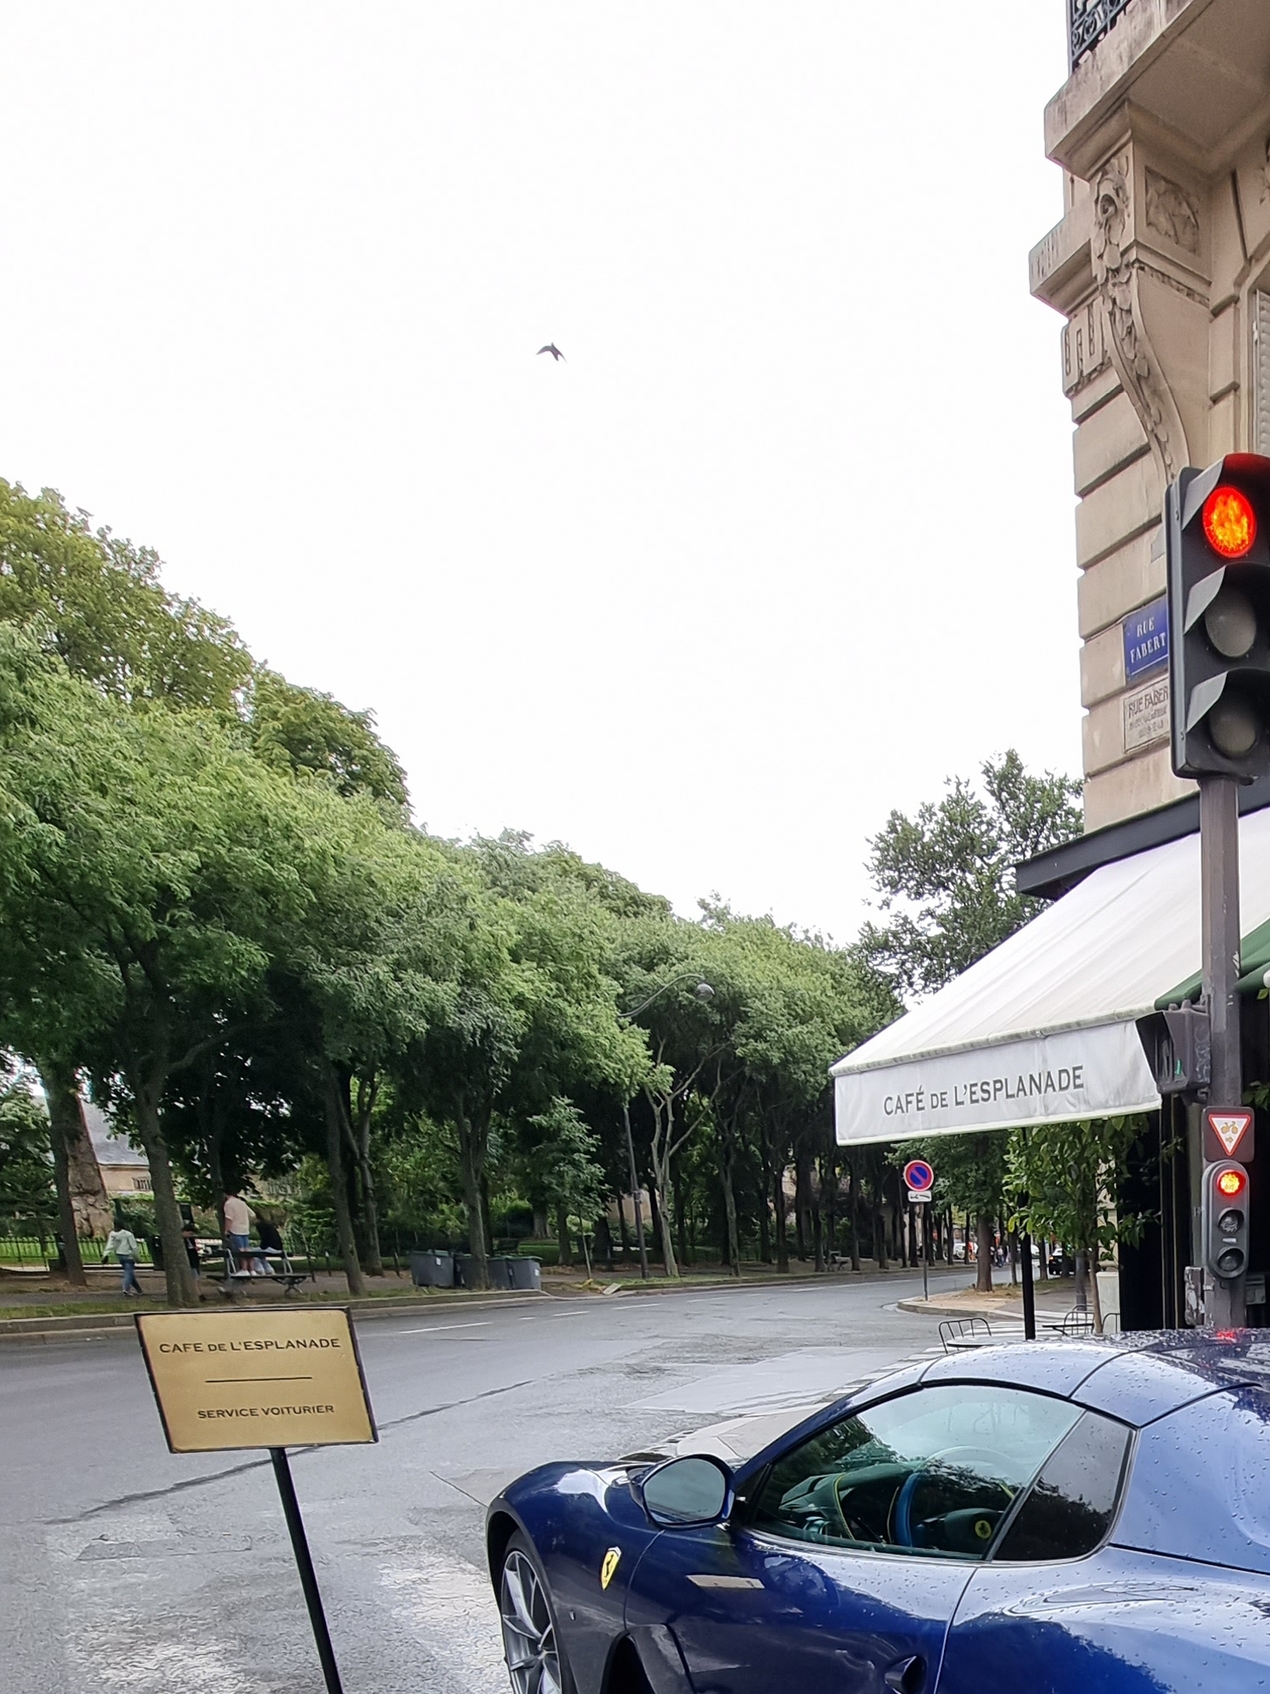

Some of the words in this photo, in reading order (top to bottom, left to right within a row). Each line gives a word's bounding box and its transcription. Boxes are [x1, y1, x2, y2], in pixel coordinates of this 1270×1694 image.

[1137, 618, 1155, 638] RUE
[1130, 631, 1166, 663] FABERT
[1128, 697, 1143, 719] RUE
[1144, 685, 1169, 711] FABER
[883, 1084, 925, 1116] CAFÉ
[931, 1091, 949, 1109] DE
[159, 1342, 204, 1353] CAFE
[208, 1343, 226, 1352] DE
[197, 1407, 259, 1419] SERVICE
[262, 1404, 335, 1416] VOITURIER
